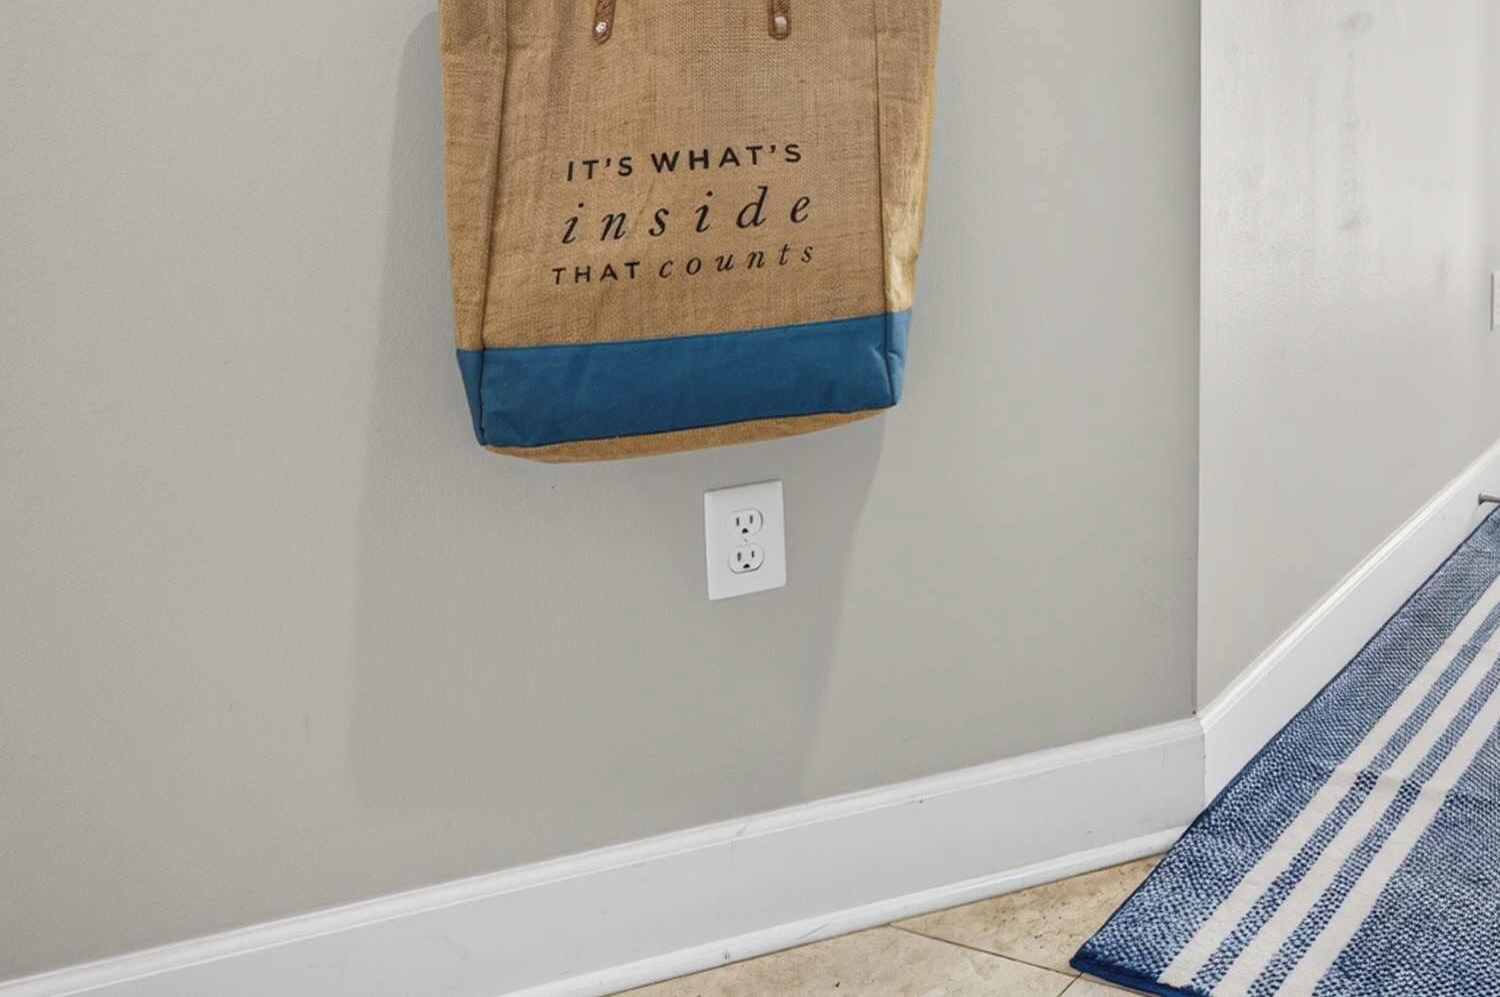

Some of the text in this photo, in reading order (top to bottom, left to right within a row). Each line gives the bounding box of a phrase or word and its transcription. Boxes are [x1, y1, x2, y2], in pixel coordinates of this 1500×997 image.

[566, 143, 803, 182] IT'S WHAT'S
[561, 185, 811, 245] inside
[552, 243, 814, 285] THAT counts
